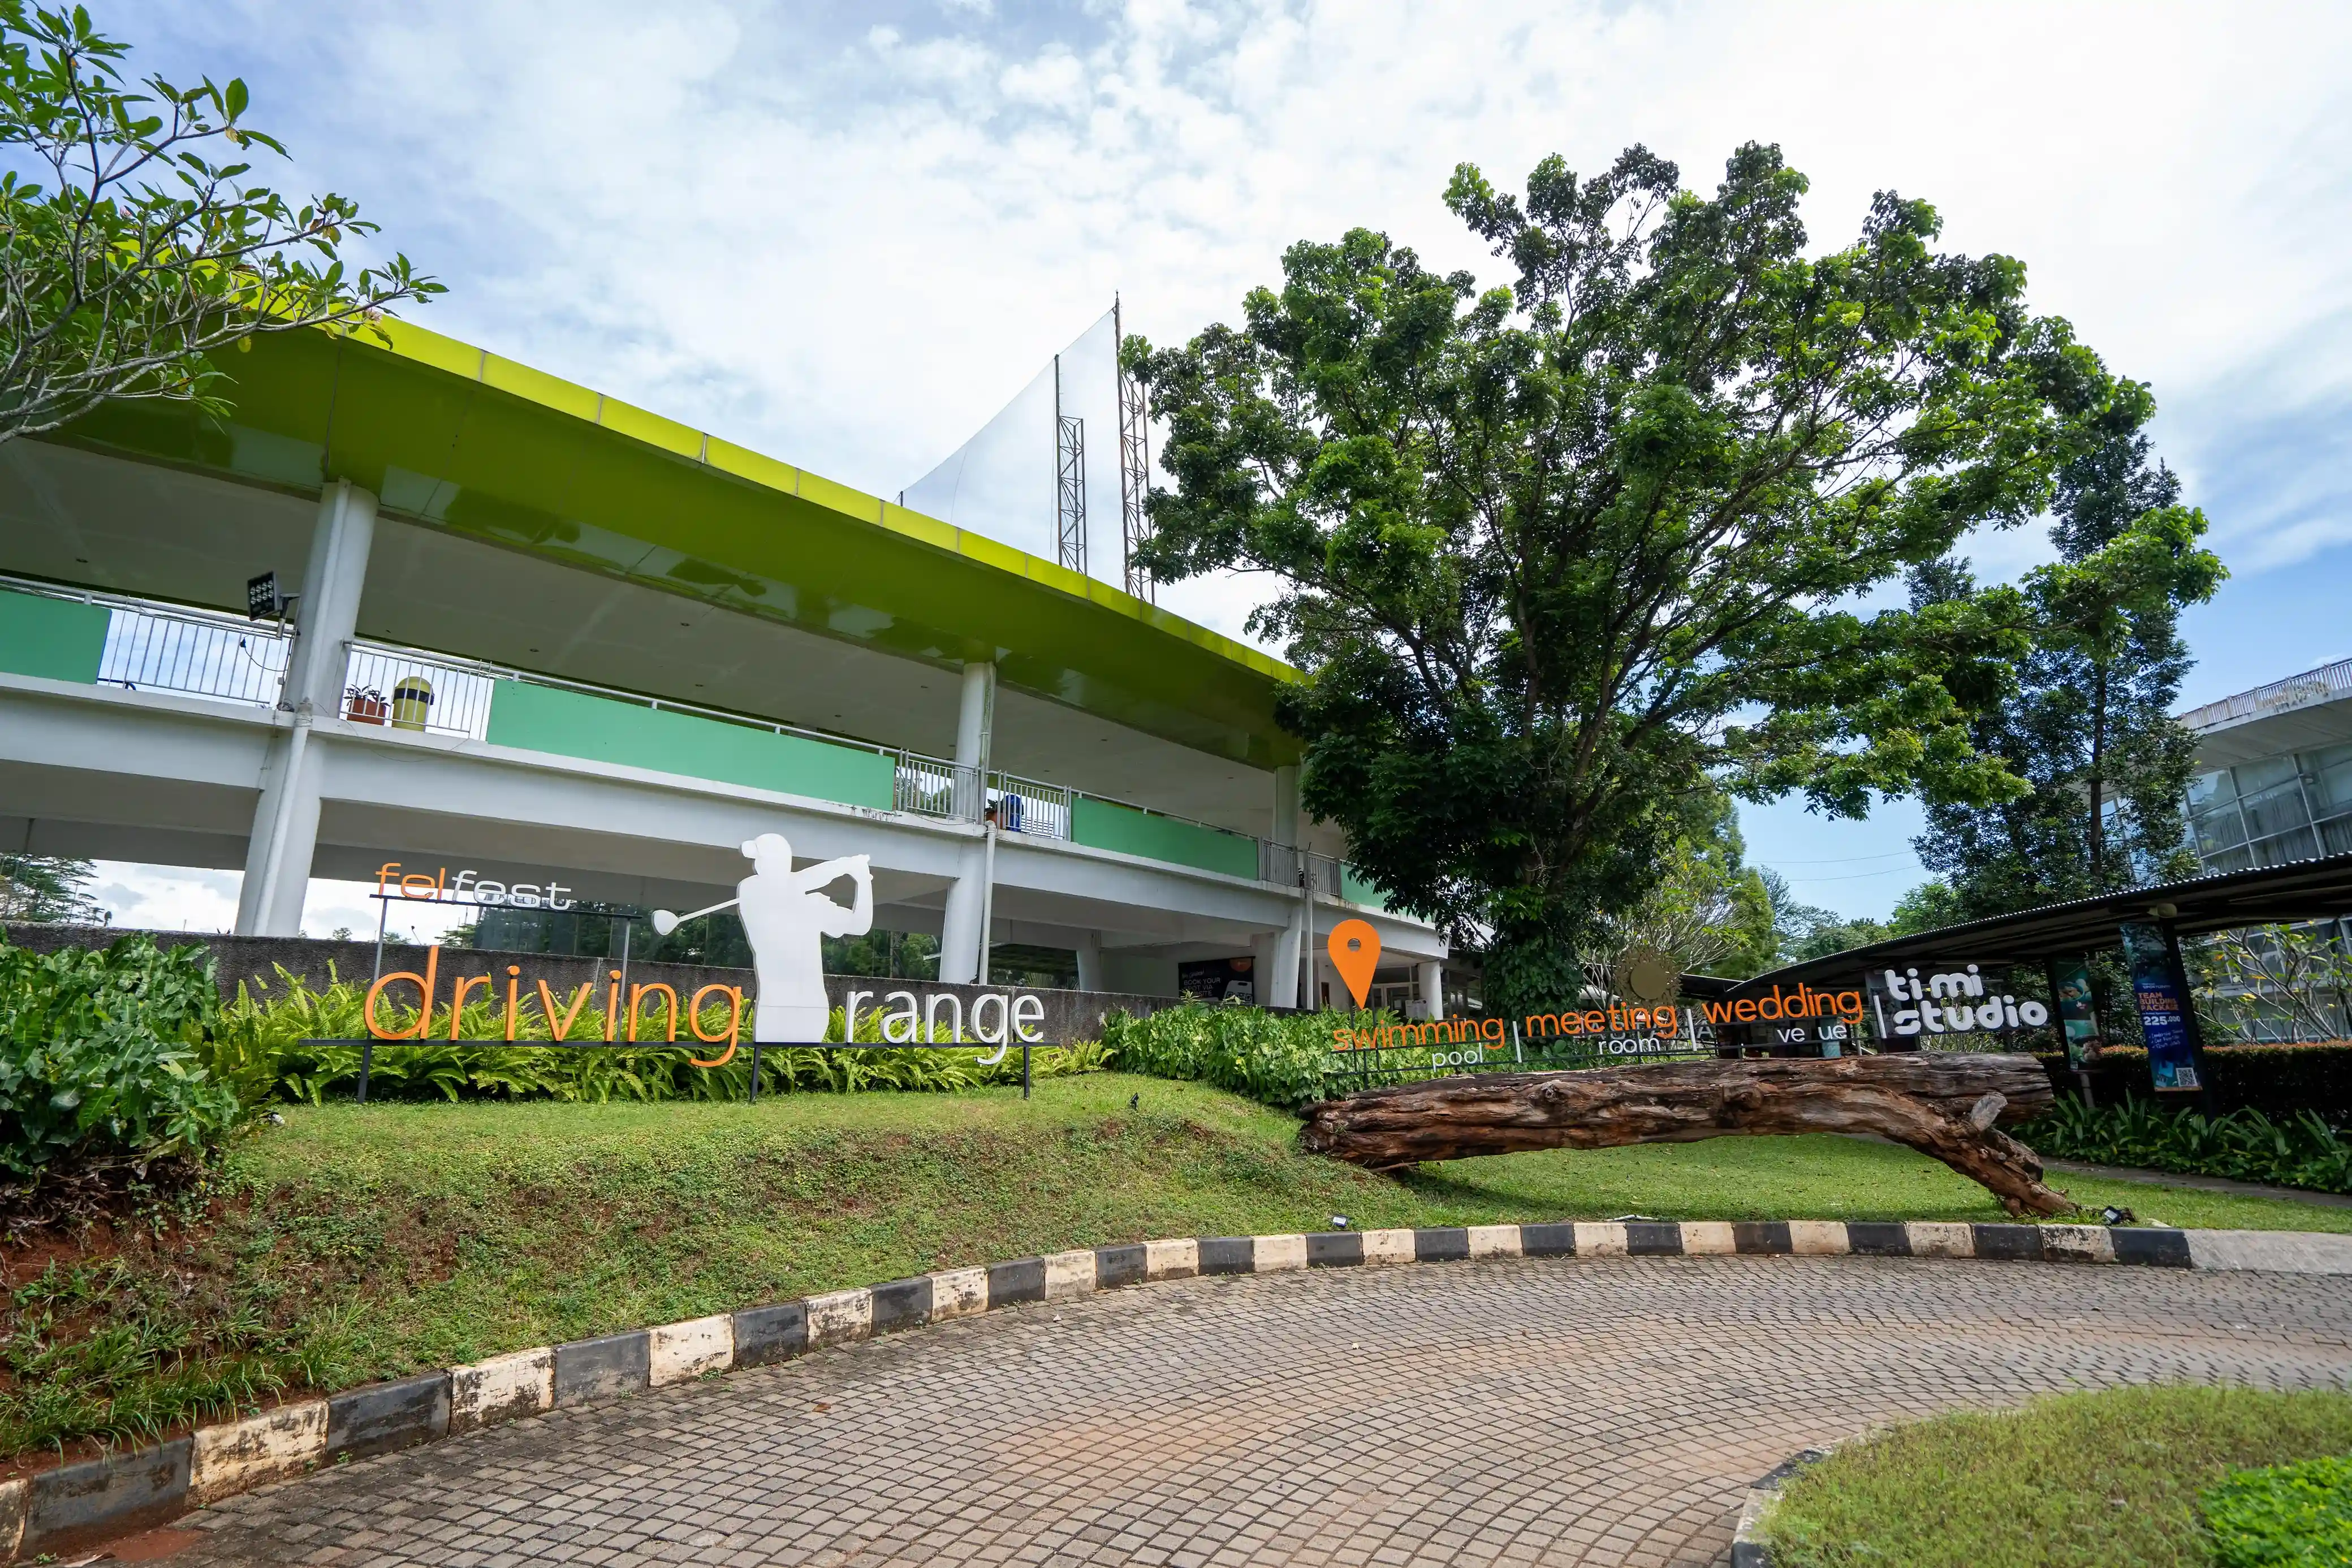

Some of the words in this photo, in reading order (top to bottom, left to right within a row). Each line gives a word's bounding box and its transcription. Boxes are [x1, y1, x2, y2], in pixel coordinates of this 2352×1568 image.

[375, 863, 572, 910] felfest
[1884, 964, 1984, 1001] timi
[364, 945, 741, 1067] driving
[845, 991, 1045, 1065] range
[1526, 1001, 1678, 1038] meeting
[1701, 982, 1863, 1024] wedding
[1893, 995, 2048, 1035] studio
[1333, 1013, 1505, 1051] swimming
[1598, 1031, 1661, 1056] room
[1432, 1042, 1483, 1073] pool
